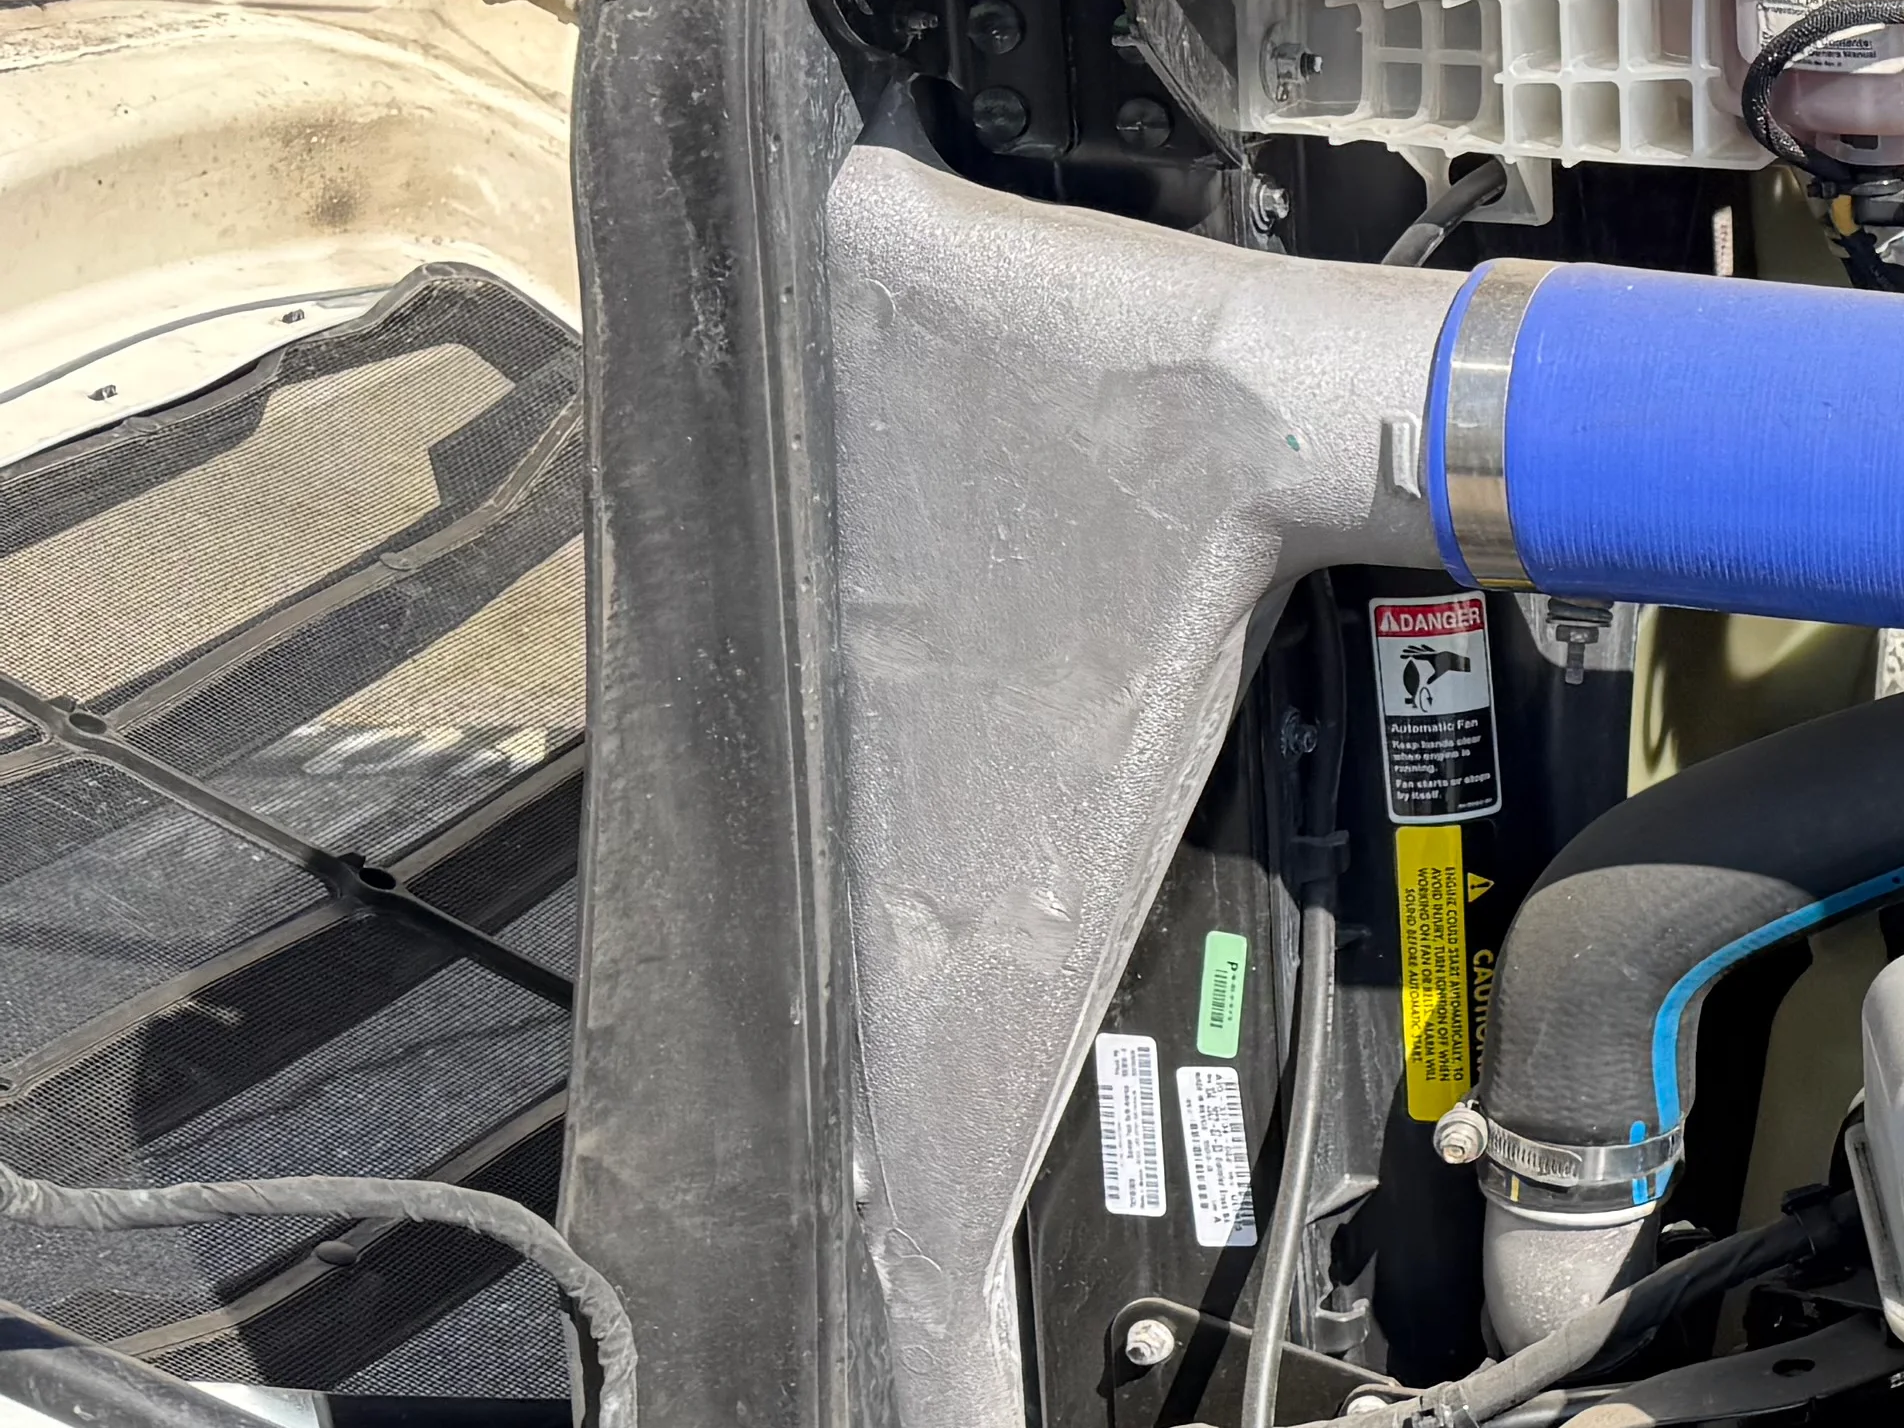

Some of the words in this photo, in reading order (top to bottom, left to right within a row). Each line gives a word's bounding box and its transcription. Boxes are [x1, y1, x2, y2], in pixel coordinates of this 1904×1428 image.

[1400, 607, 1481, 632] DANGER
[1391, 722, 1455, 734] Automatic
[1457, 719, 1479, 730] Fan
[1396, 778, 1414, 789] Fan
[1417, 868, 1430, 920] WORKING
[1432, 868, 1444, 900] AVOID
[1445, 867, 1457, 906] ENGINE
[1405, 888, 1417, 926] SOUND
[1419, 924, 1431, 941] ON
[1447, 910, 1459, 944] COULD
[1407, 929, 1419, 967] BEFORE
[1420, 945, 1432, 965] FAN
[1435, 946, 1446, 973] TURN
[1449, 948, 1460, 976] START
[1422, 968, 1432, 983] OR
[1409, 970, 1421, 1030] AUTOMATIC
[1435, 977, 1448, 1024] IGNITION
[1424, 1022, 1436, 1056] ALARM
[1438, 1027, 1449, 1046] OFF
[1425, 1059, 1437, 1081] WILL
[1439, 1050, 1451, 1082] WHEN
[1454, 1069, 1464, 1081] TO
